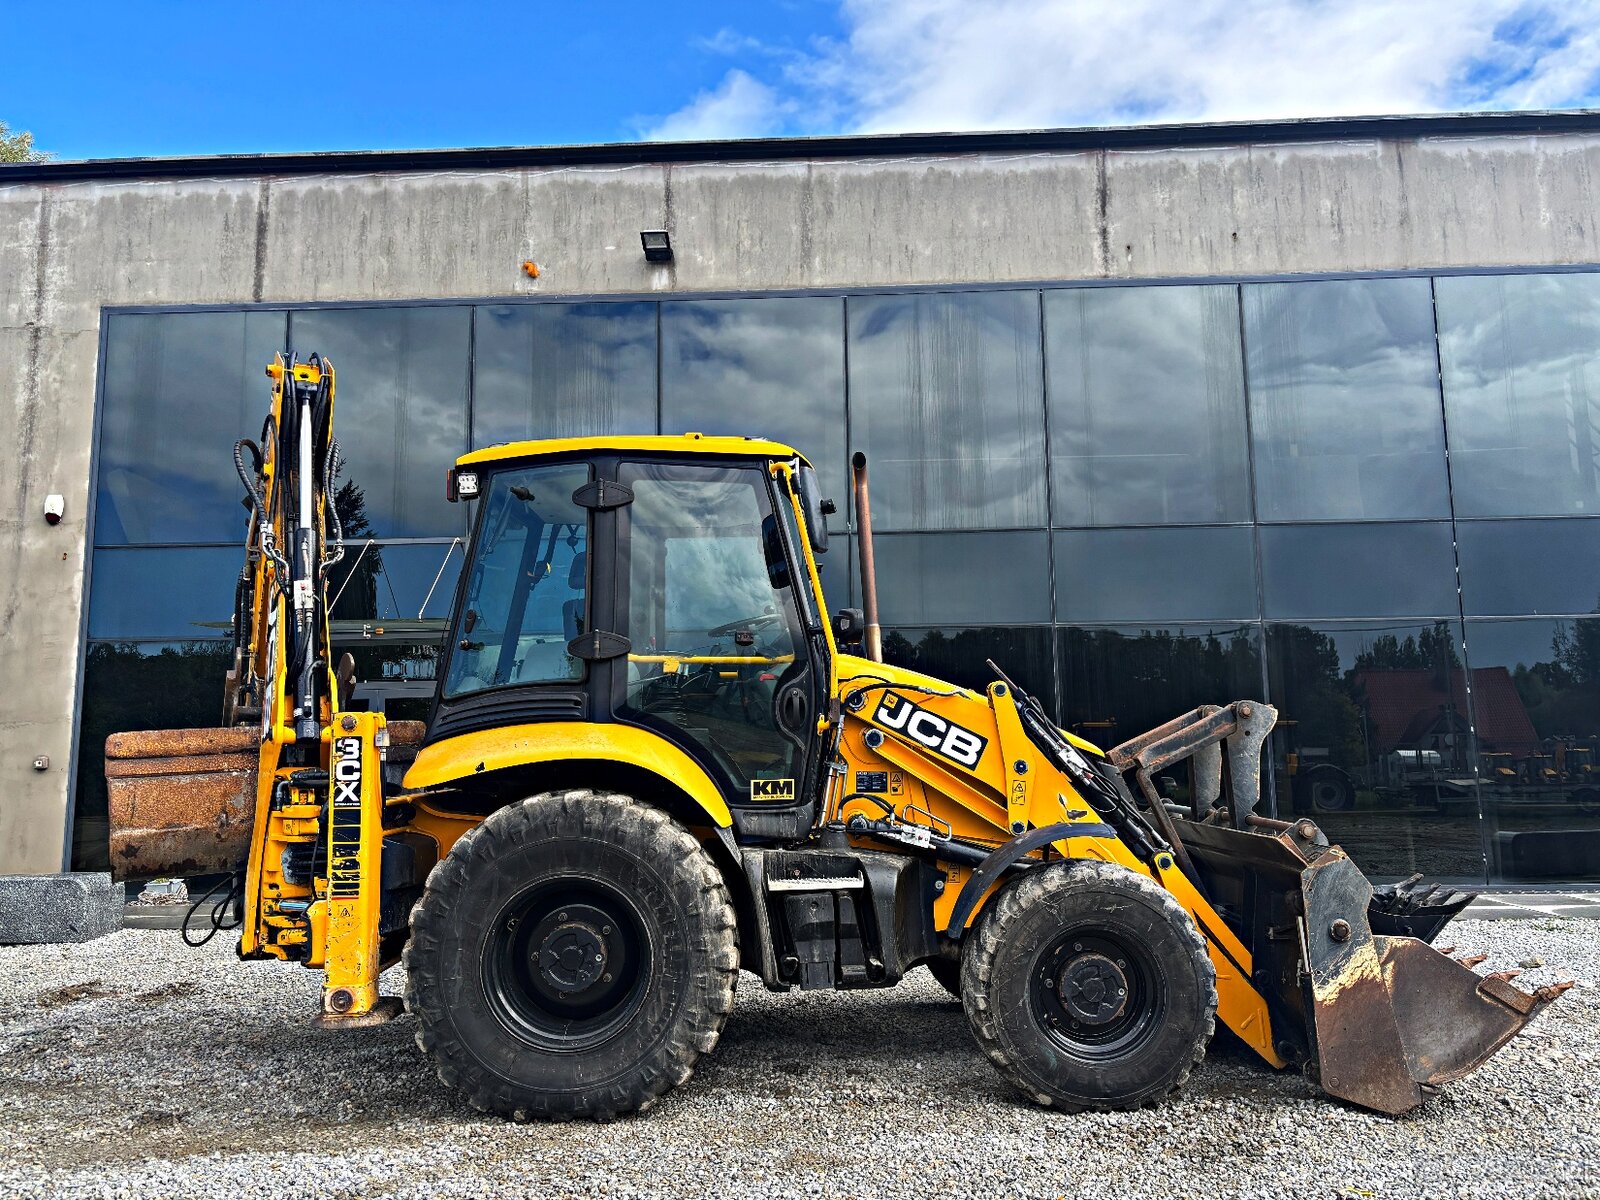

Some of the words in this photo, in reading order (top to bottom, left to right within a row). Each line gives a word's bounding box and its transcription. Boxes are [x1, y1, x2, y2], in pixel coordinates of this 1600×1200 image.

[877, 701, 983, 766] JCB
[334, 738, 361, 802] 3CX
[753, 780, 793, 795] KM
